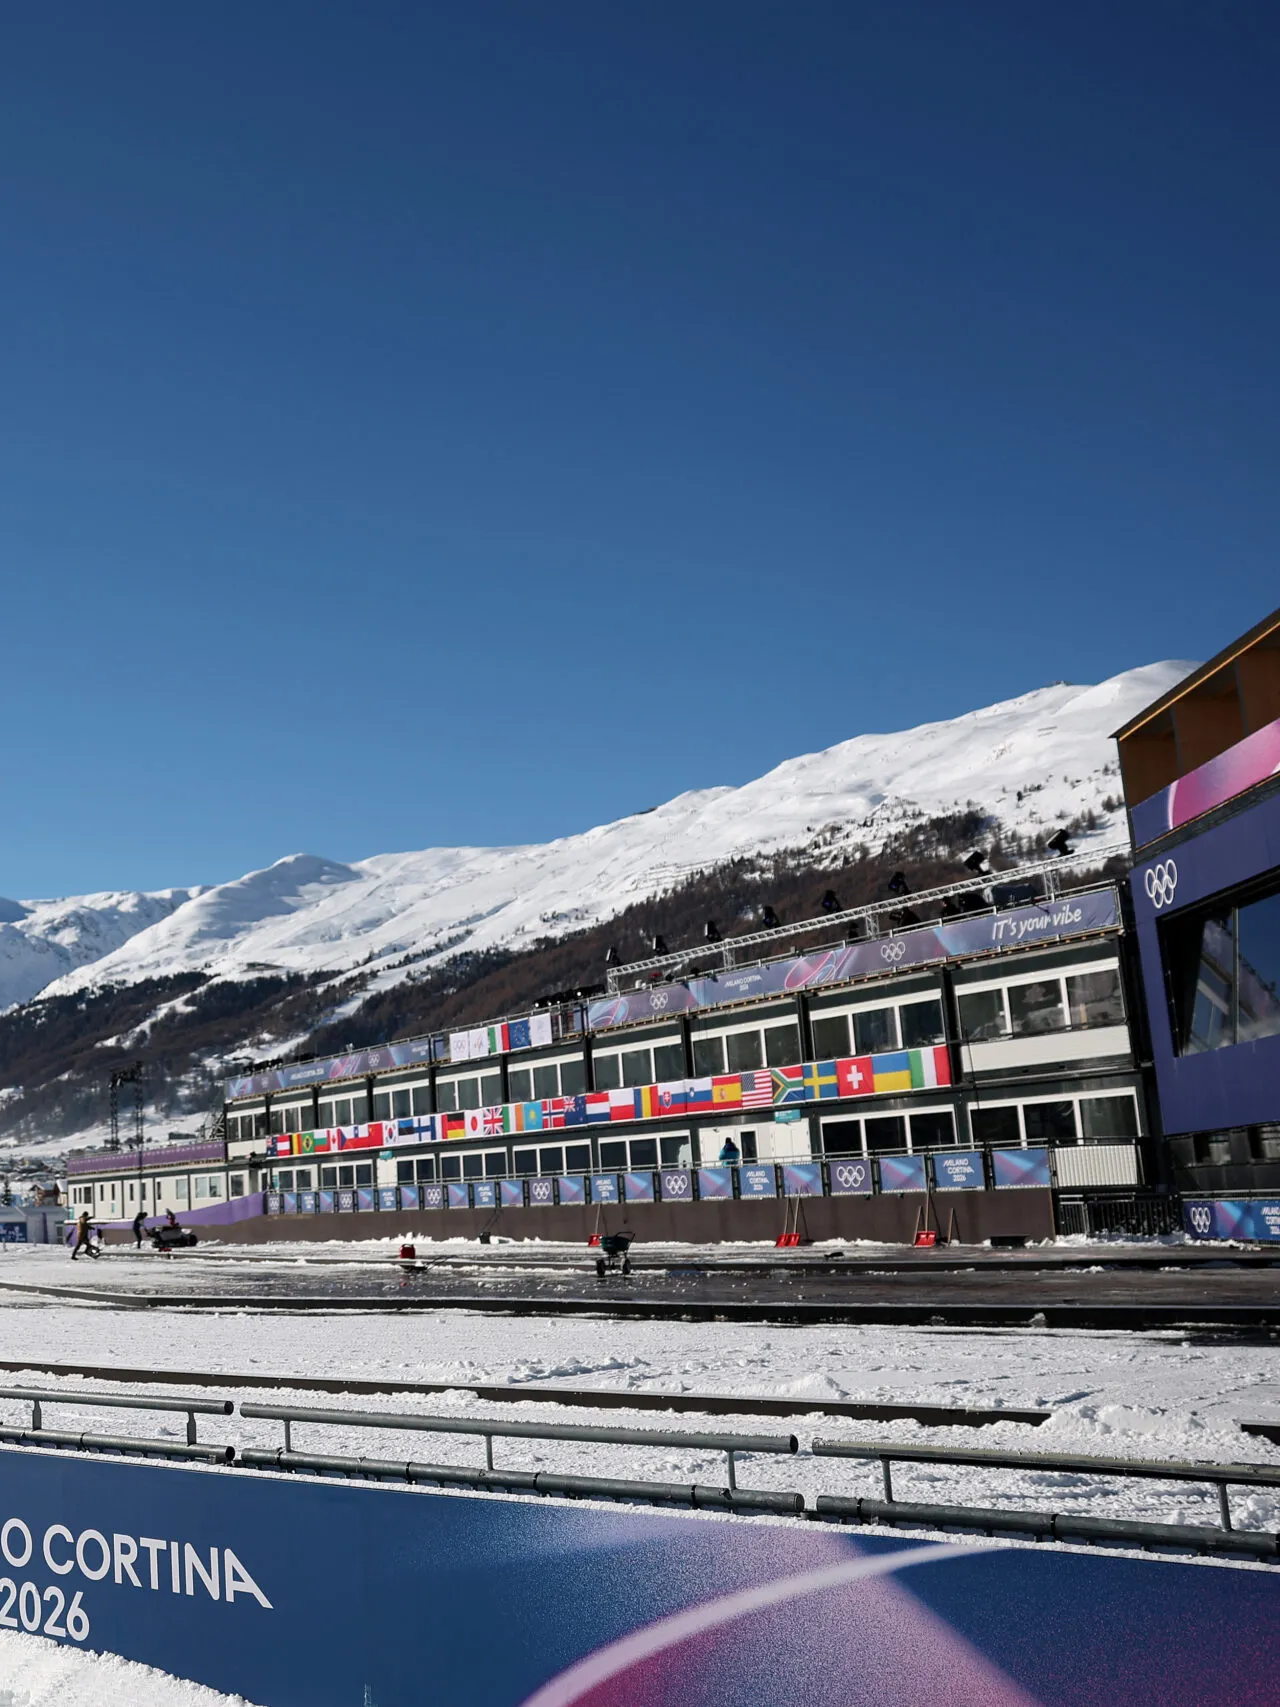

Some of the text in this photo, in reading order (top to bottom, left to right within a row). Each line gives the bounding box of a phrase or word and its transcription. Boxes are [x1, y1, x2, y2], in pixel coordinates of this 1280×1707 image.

[992, 904, 1082, 940] IT's your vibe
[943, 1158, 968, 1167] MILANO
[947, 1166, 975, 1174] CORTINA
[42, 1523, 274, 1609] CORTINA
